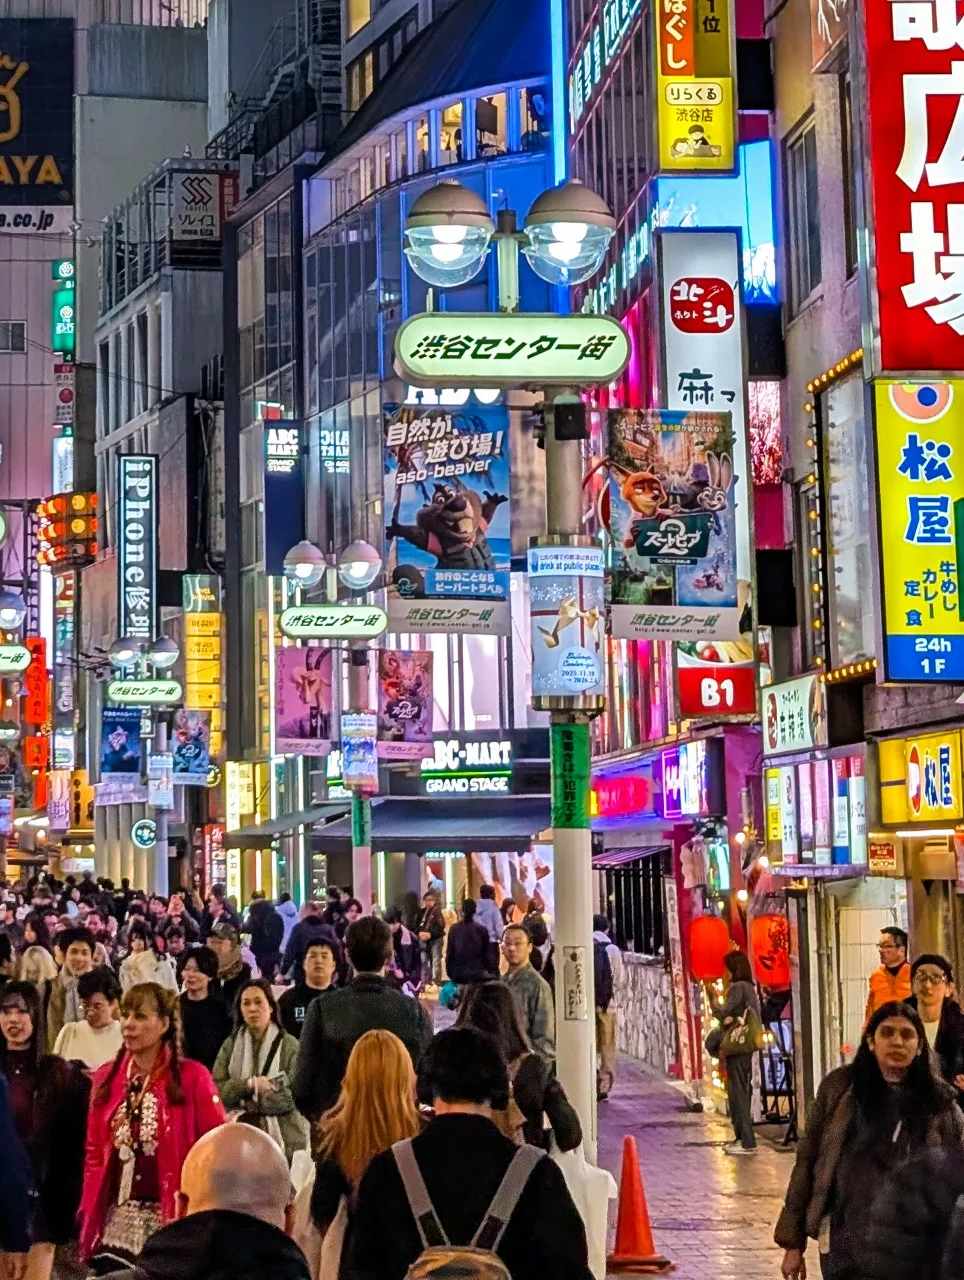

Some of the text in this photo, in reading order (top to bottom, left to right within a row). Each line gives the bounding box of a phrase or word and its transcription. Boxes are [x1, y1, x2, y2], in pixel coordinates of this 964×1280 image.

[670, 86, 718, 101] りらくる
[676, 108, 714, 122] 渋谷店
[409, 334, 618, 362] 渋谷センター街
[267, 428, 299, 445] ABC
[267, 444, 299, 456] MART
[396, 459, 492, 486] aso-beaver
[897, 434, 953, 544] 松屋
[644, 529, 702, 548] ズートピア
[923, 569, 939, 619] カレー
[939, 560, 957, 612] 牛めし
[904, 580, 923, 627] 定食
[285, 613, 380, 627] 渋谷センター街
[407, 607, 495, 621] 渋谷センター街
[630, 612, 720, 627] 渋谷センター街
[914, 637, 952, 653] 24h
[920, 658, 947, 676] 1F
[110, 684, 178, 697] 渋谷センター街
[700, 677, 734, 707] B1
[426, 777, 509, 793] GRAND STAGE
[924, 745, 953, 808] 松屋
